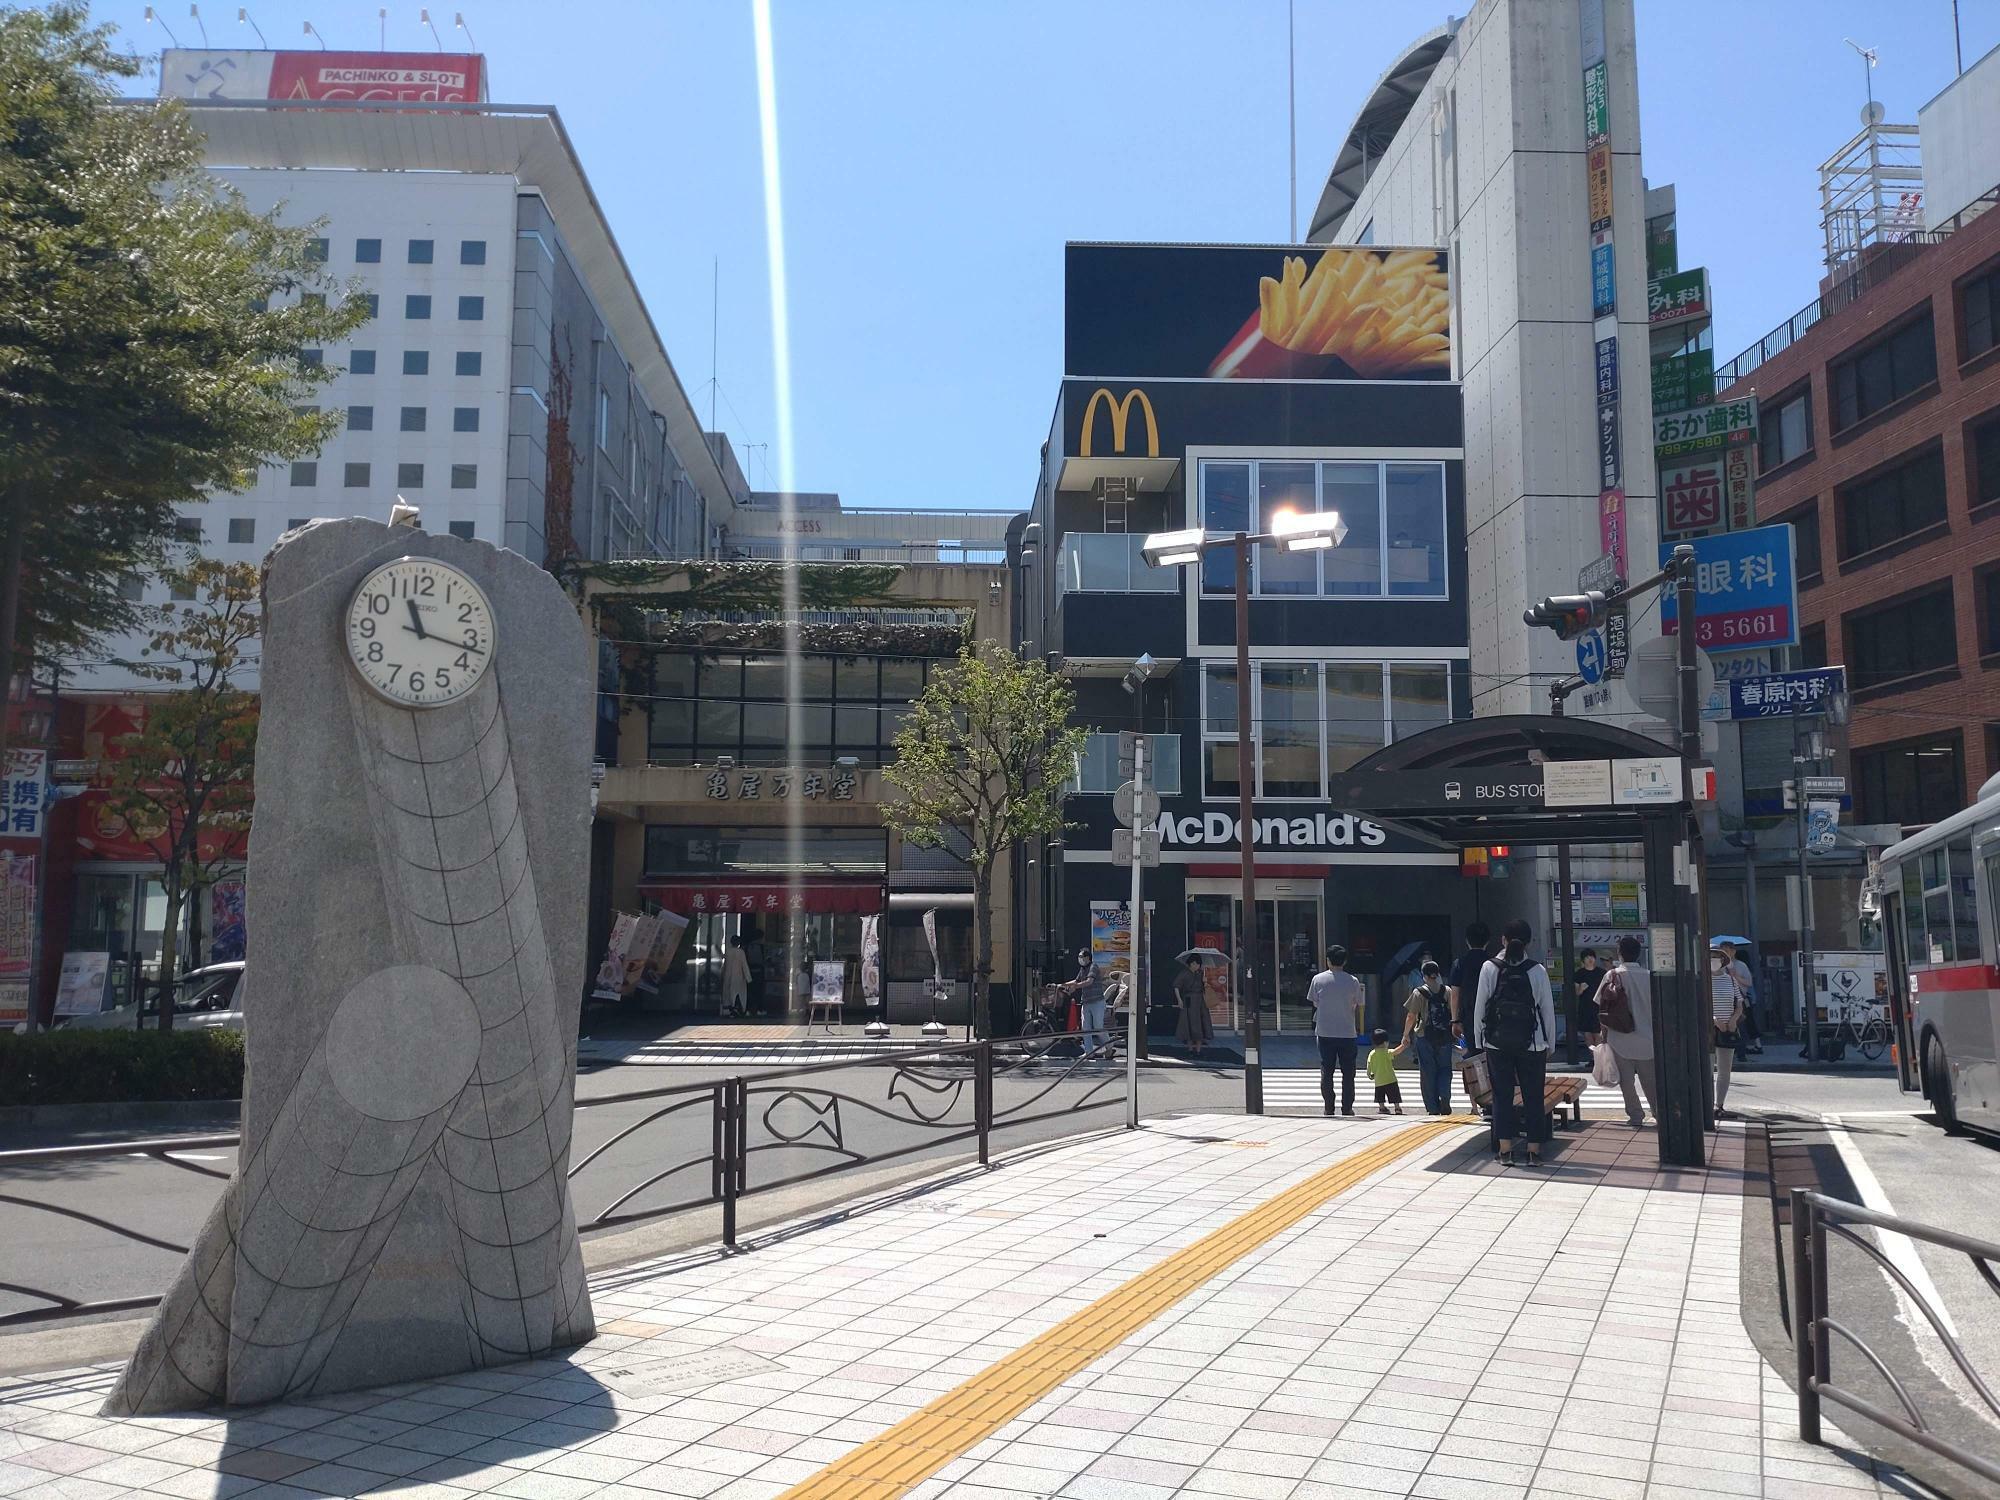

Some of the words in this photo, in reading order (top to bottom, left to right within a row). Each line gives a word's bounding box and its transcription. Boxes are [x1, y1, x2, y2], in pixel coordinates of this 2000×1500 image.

[325, 70, 399, 82] PACHINKO
[403, 72, 415, 82] &
[419, 72, 460, 85] SLOT
[1585, 68, 1599, 138] 整形外科
[1592, 218, 1610, 231] 4F
[1596, 249, 1609, 304] 新城眼科
[1650, 286, 1701, 313] 外科
[1600, 340, 1612, 392] 春原内科
[1653, 402, 1753, 442] おか歯科
[1665, 469, 1721, 530] 歯
[414, 575, 435, 597] 12
[368, 593, 390, 615] 10
[457, 603, 473, 624] 2
[359, 617, 376, 639] 9
[1723, 614, 1777, 638] 5661
[462, 629, 478, 651] 3
[367, 641, 384, 663] 8
[453, 652, 470, 672] 4
[387, 663, 403, 684] 7
[409, 671, 425, 692] 6
[434, 667, 451, 688] 5
[1741, 677, 1831, 706] 春原内科
[1759, 700, 1814, 716] クリニク
[705, 772, 857, 801] 亀屋万年堂
[1475, 785, 1506, 799] BUS
[692, 893, 806, 910] 亀屋万年堂
[1583, 933, 1646, 945] シンノウ局
